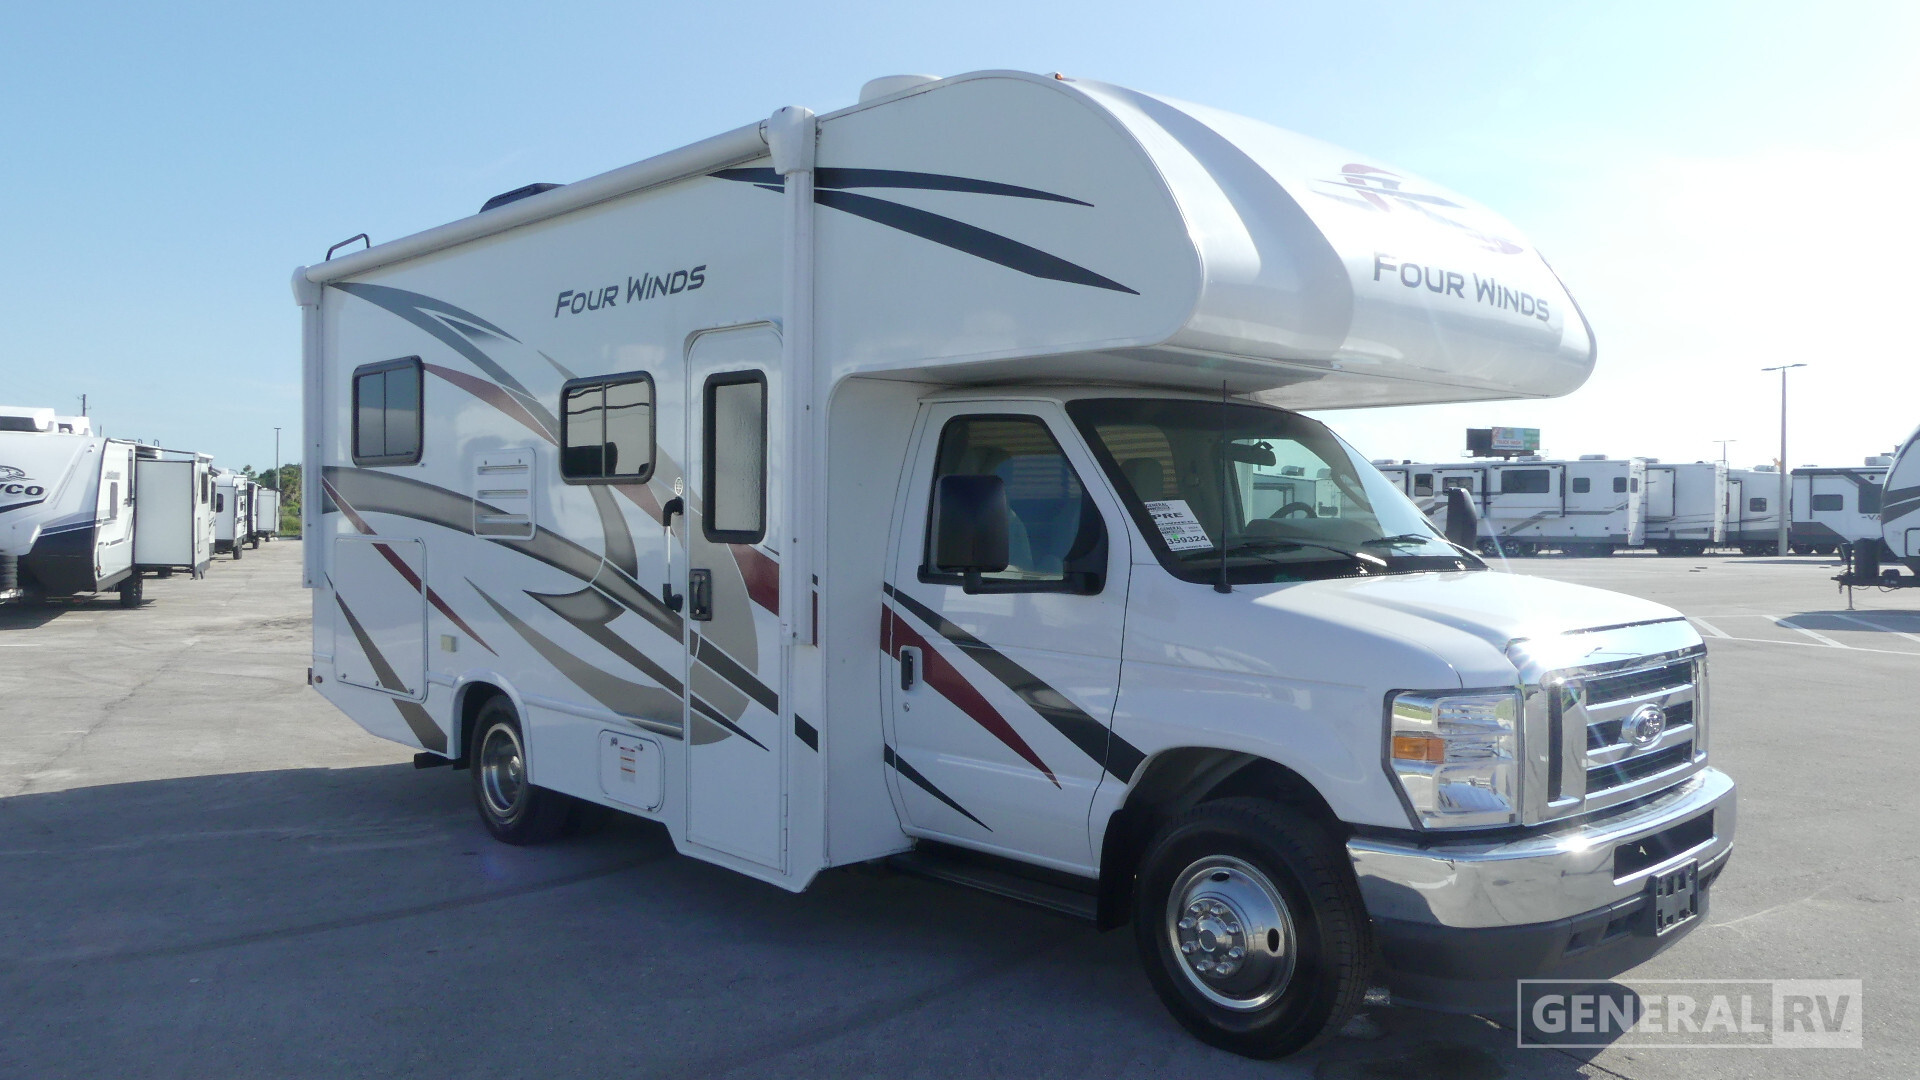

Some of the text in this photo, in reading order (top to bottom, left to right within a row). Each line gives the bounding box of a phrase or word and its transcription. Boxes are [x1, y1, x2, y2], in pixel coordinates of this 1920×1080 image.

[554, 264, 707, 318] FOUR WINDS
[1373, 251, 1550, 322] FOUR WINDS
[1167, 535, 1208, 545] 359324
